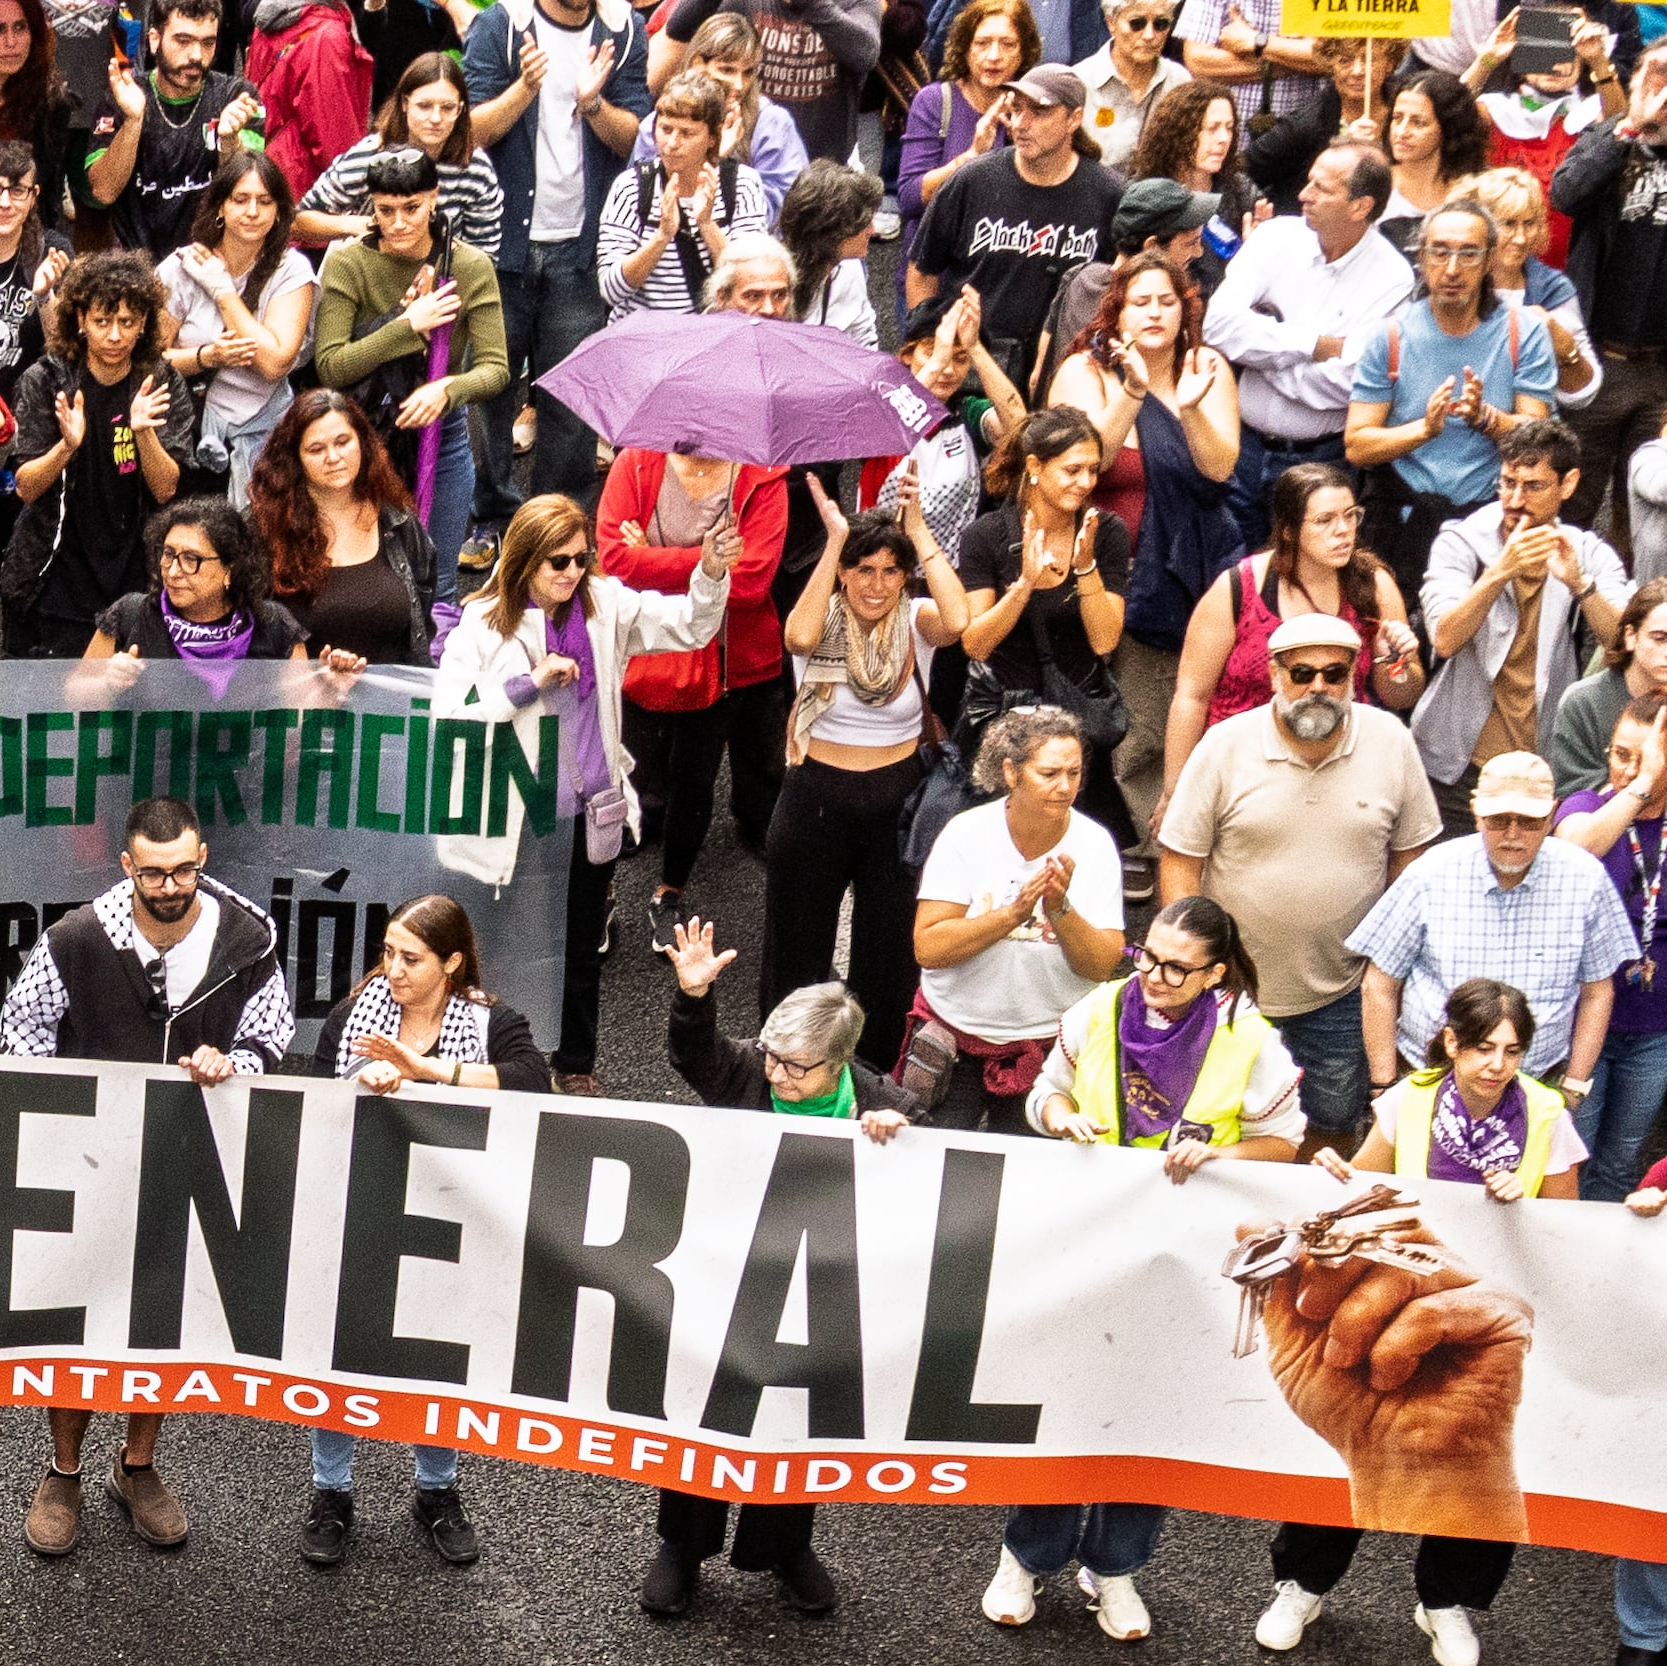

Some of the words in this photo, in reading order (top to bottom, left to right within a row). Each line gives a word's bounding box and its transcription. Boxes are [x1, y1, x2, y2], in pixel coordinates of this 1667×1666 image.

[1328, 0, 1348, 12] LA
[1357, 0, 1420, 12] TIERRA
[425, 1401, 969, 1496] INDEFINIDOS
